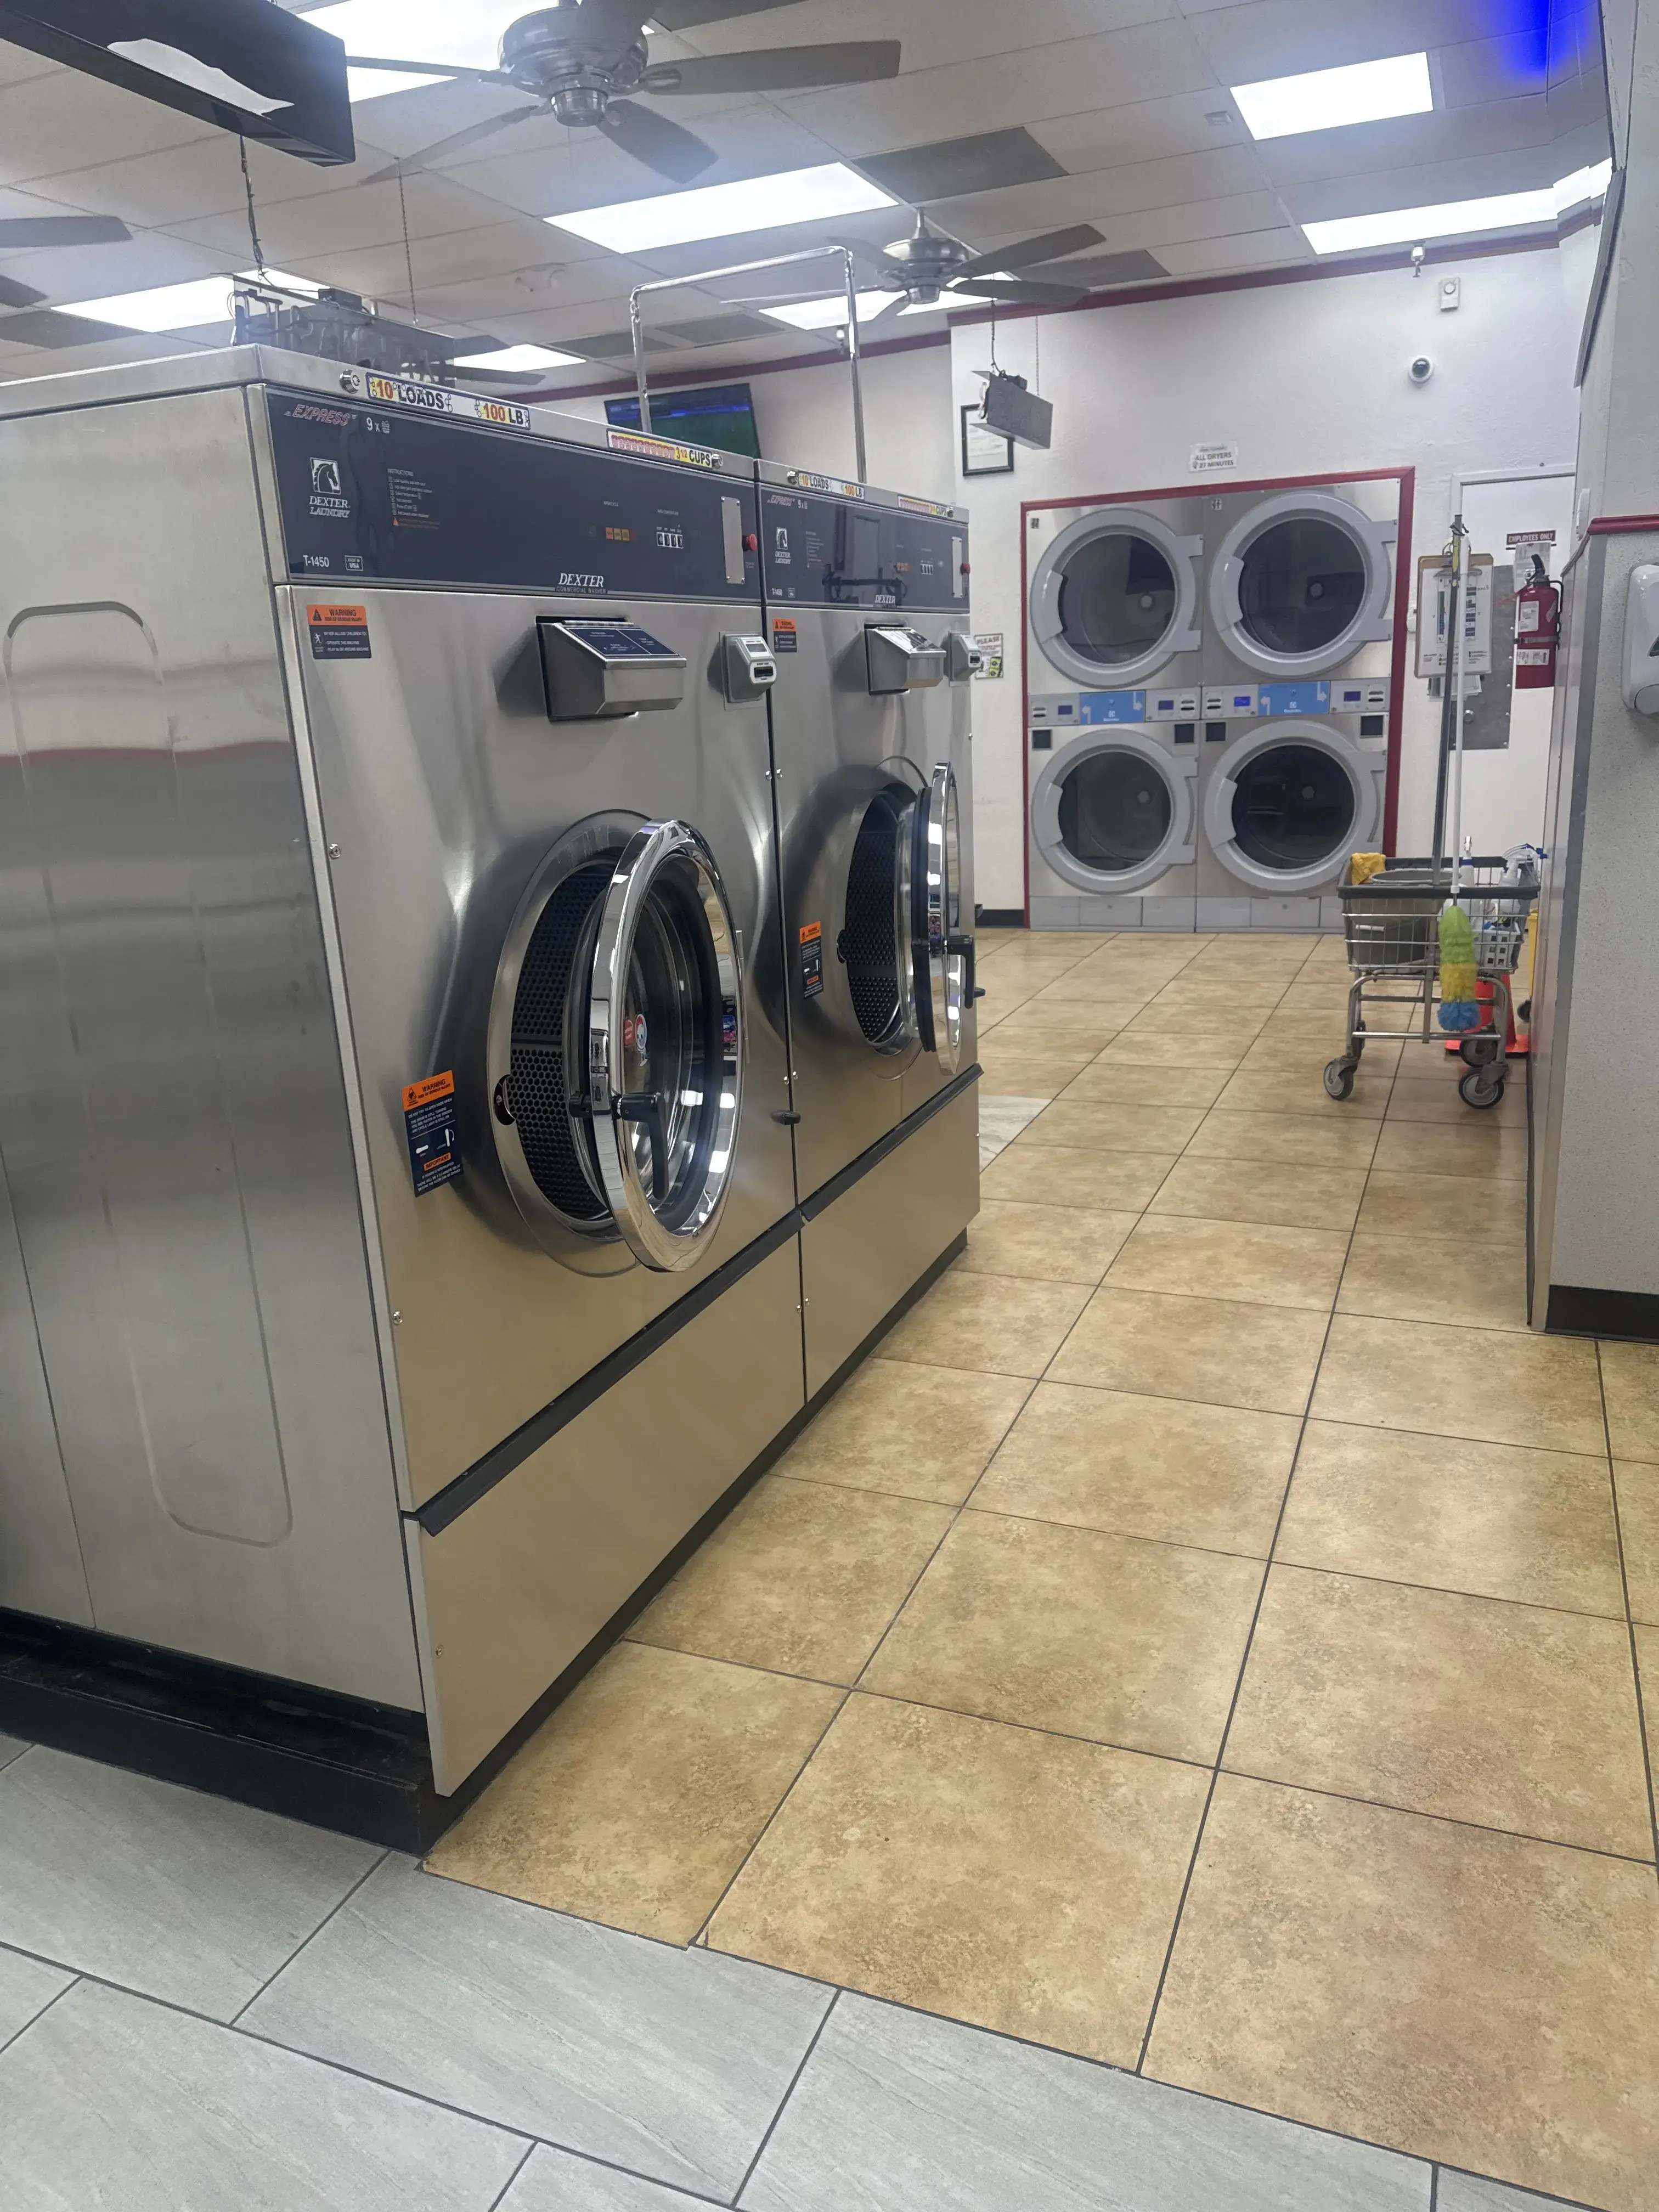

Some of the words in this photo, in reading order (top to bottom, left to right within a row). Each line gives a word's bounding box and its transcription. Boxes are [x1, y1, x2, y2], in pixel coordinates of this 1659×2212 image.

[376, 380, 393, 399] 10
[397, 384, 444, 409] LOADS
[483, 403, 506, 421] 100
[508, 408, 523, 425] LB
[292, 404, 350, 426] EXPRESS
[366, 417, 373, 431] 9
[375, 422, 380, 432] x
[675, 447, 680, 460] 3
[689, 450, 710, 466] CUPS
[1207, 452, 1232, 460] DRYERS
[802, 475, 809, 486] 10
[810, 476, 829, 490] LOADS
[309, 495, 349, 509] DEXTER
[309, 507, 351, 518] LAUNDRY
[1508, 534, 1539, 543] EMPLOYEES
[302, 555, 329, 567] T-1450
[558, 573, 604, 588] DEXTER
[874, 594, 896, 604] DEXTER
[422, 1079, 446, 1092] WARNING
[426, 1154, 449, 1169] IMPORTANT
